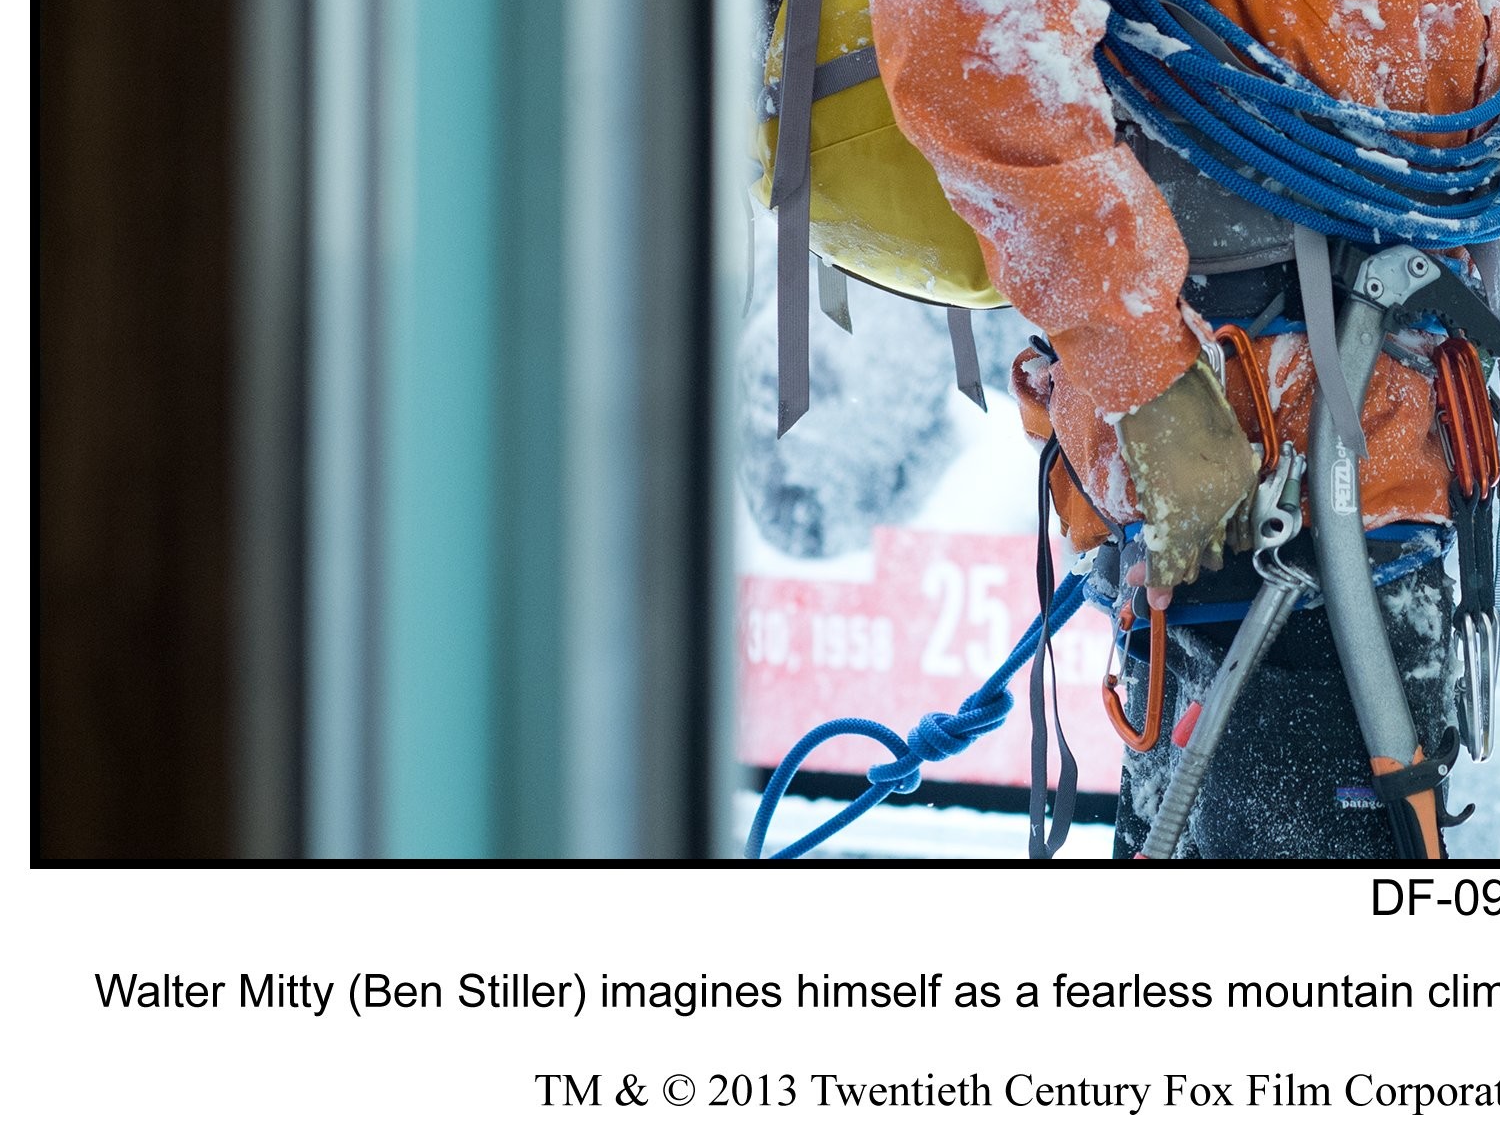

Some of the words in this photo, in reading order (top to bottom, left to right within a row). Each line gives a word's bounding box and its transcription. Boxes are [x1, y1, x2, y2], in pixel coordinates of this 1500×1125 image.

[1335, 458, 1358, 515] PETZL
[812, 614, 894, 673] 1958
[922, 560, 1011, 679] 25
[1342, 799, 1385, 810] patago
